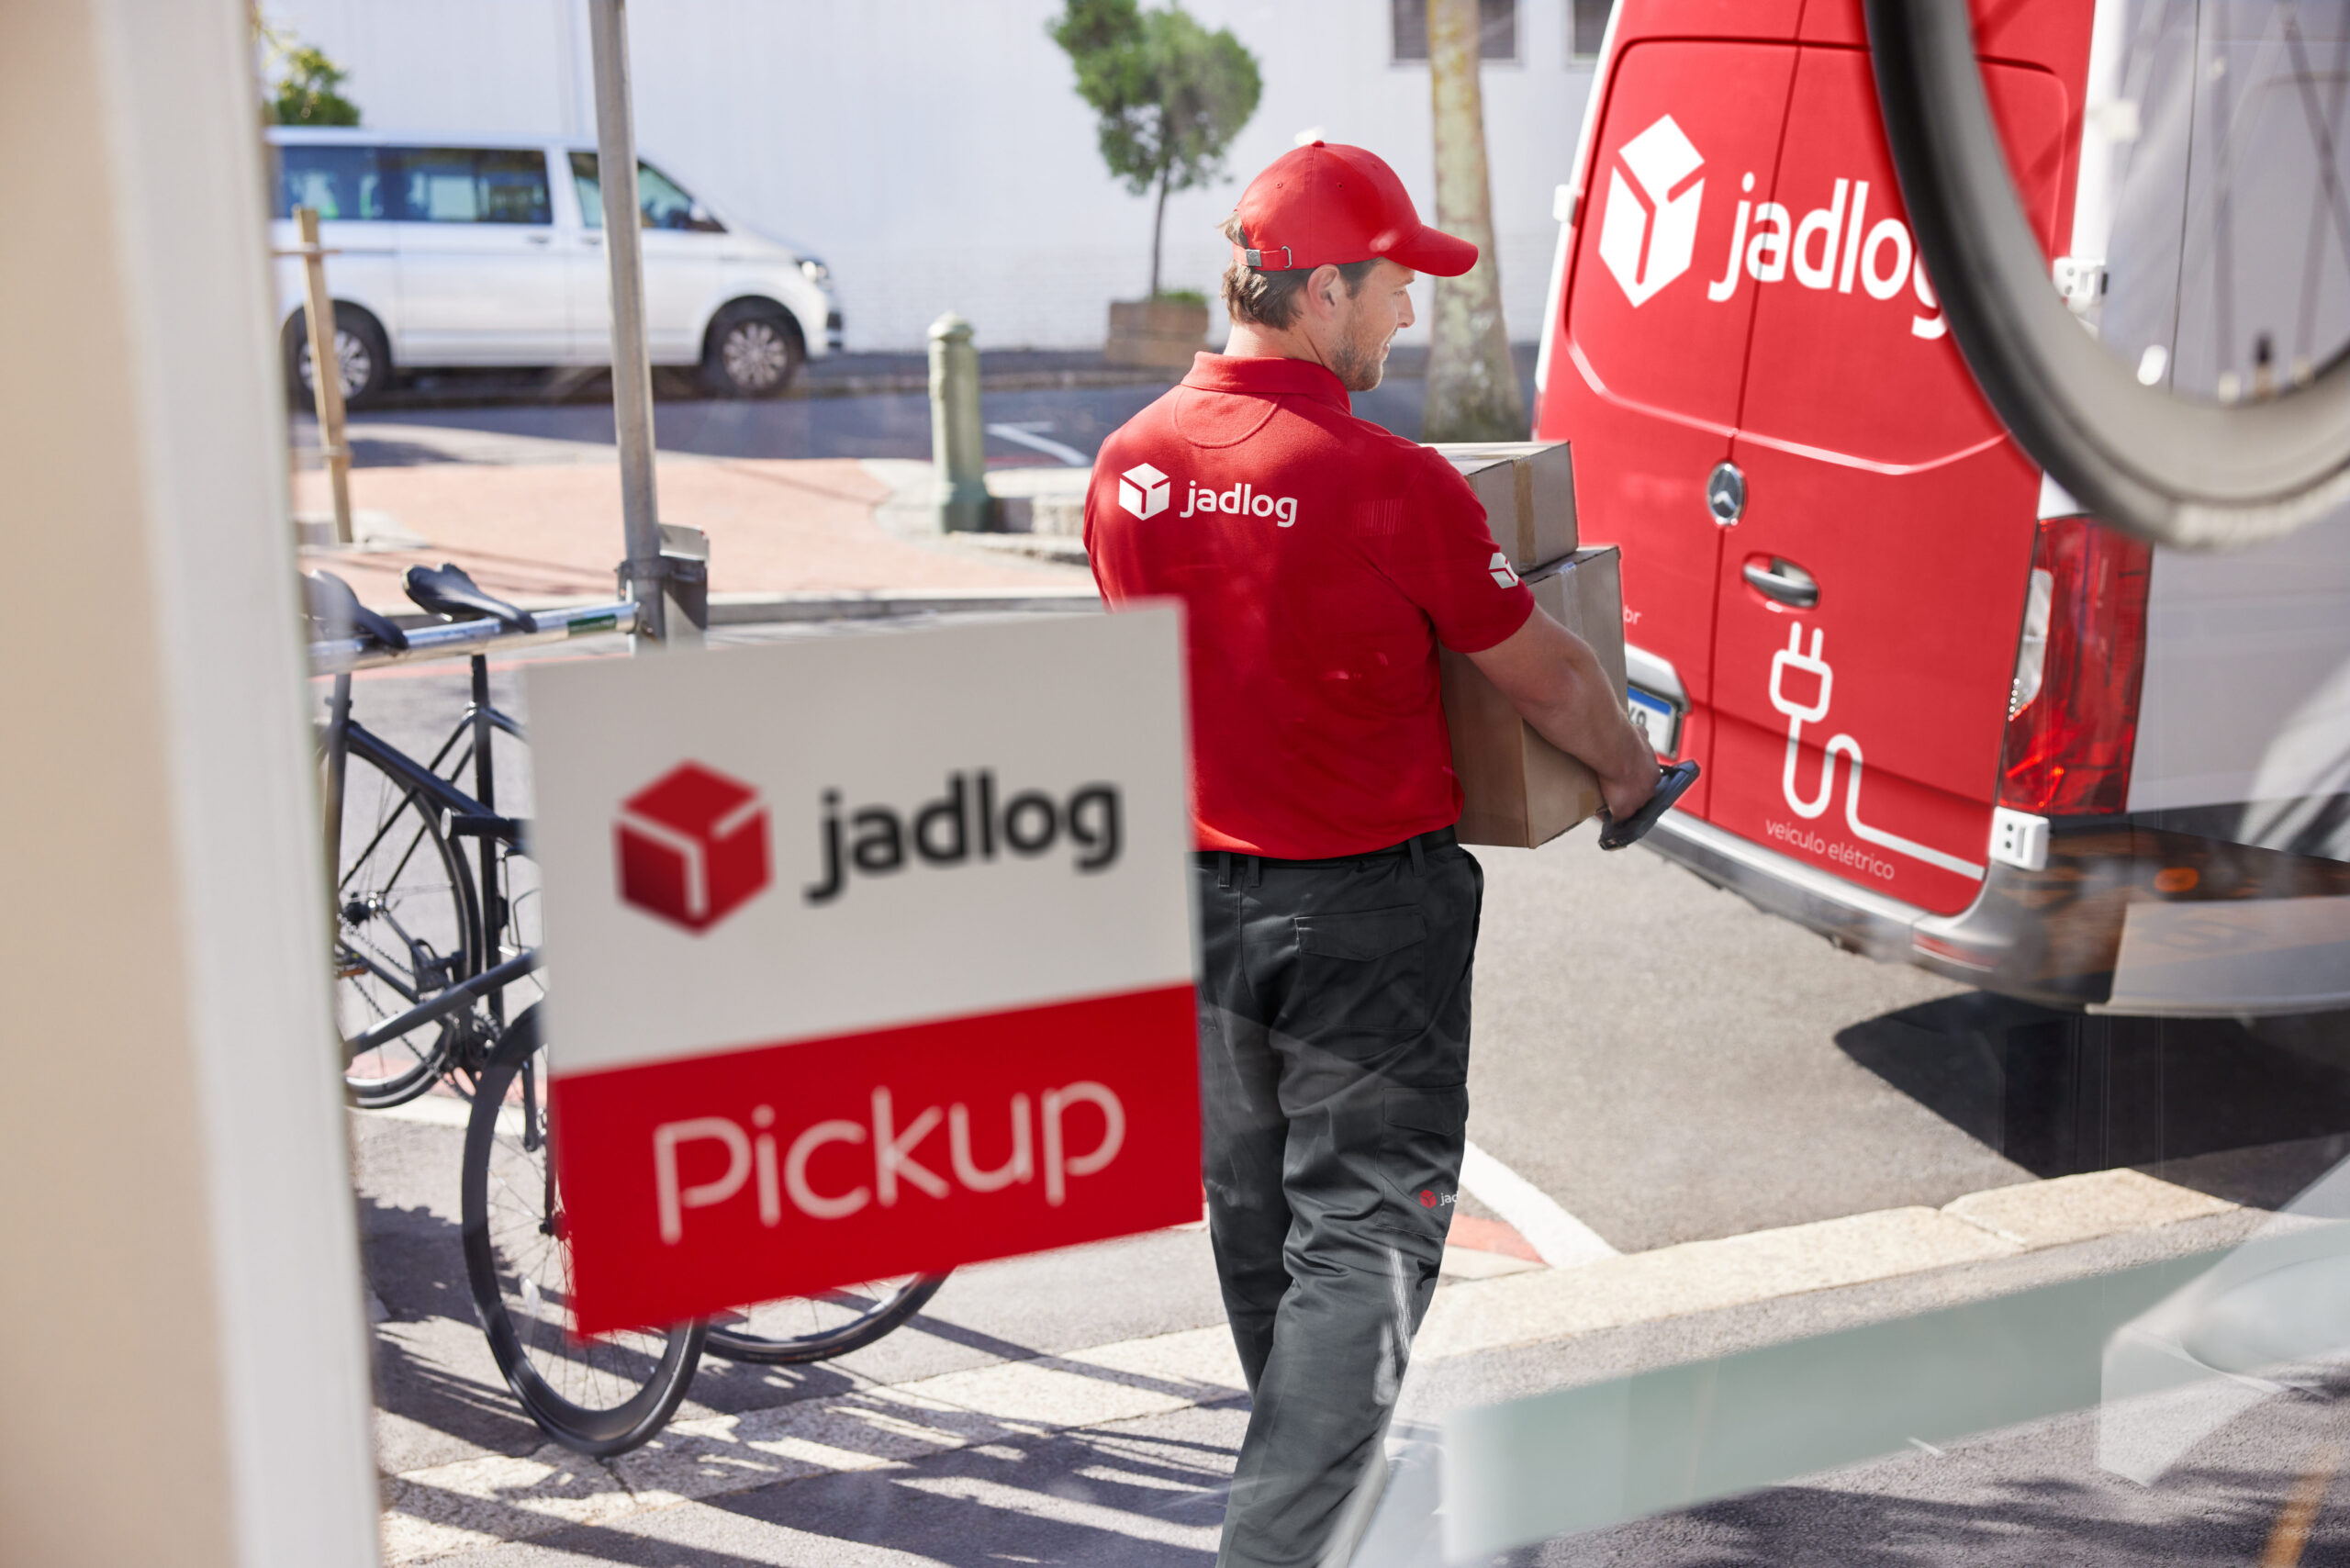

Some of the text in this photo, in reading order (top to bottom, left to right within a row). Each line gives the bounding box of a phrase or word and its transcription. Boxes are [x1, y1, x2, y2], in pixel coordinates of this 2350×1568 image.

[1180, 480, 1298, 528] jadlog
[803, 766, 1125, 906] jadlog
[1828, 842, 1895, 879] elétrico
[653, 1081, 1126, 1245] Pickup
